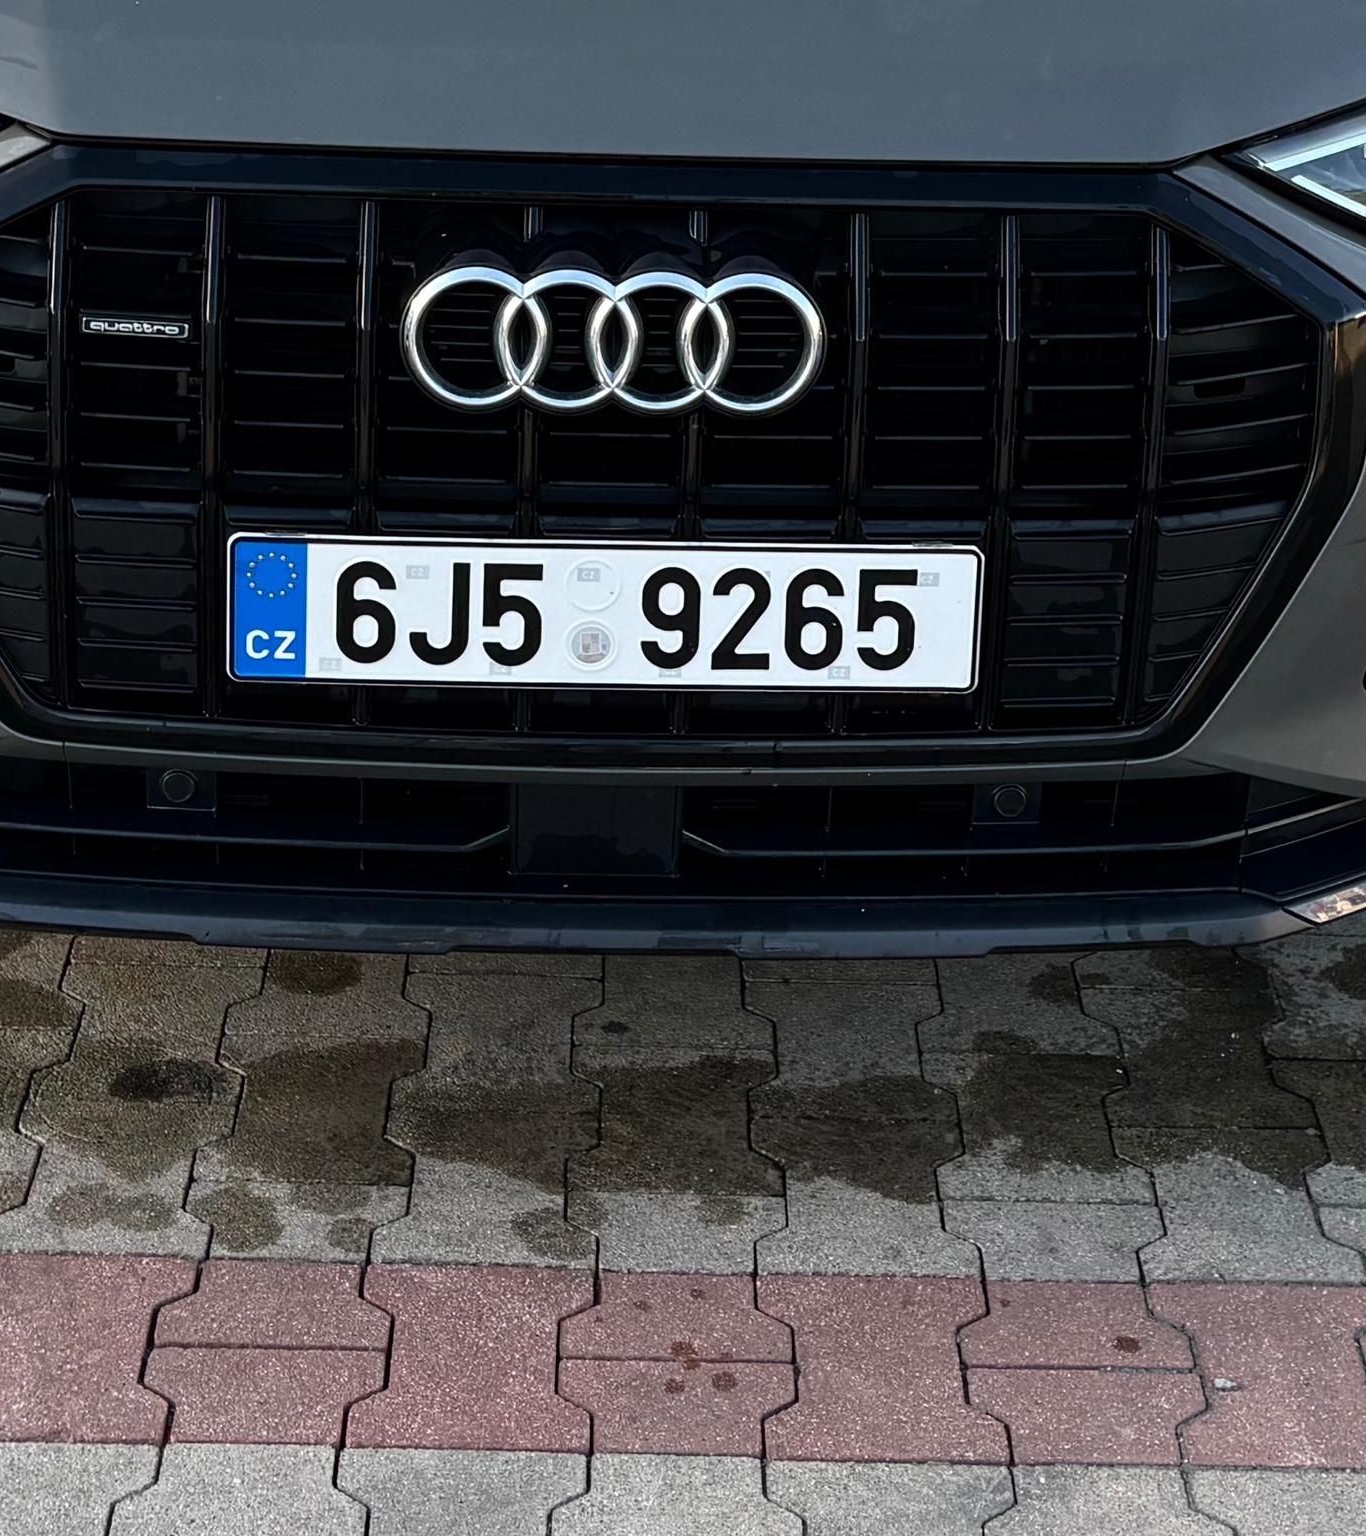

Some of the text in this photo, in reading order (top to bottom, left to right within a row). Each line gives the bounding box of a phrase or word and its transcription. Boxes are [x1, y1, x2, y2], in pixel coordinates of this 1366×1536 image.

[90, 321, 180, 335] quattro
[245, 560, 919, 672] CZ 6J5 9265
